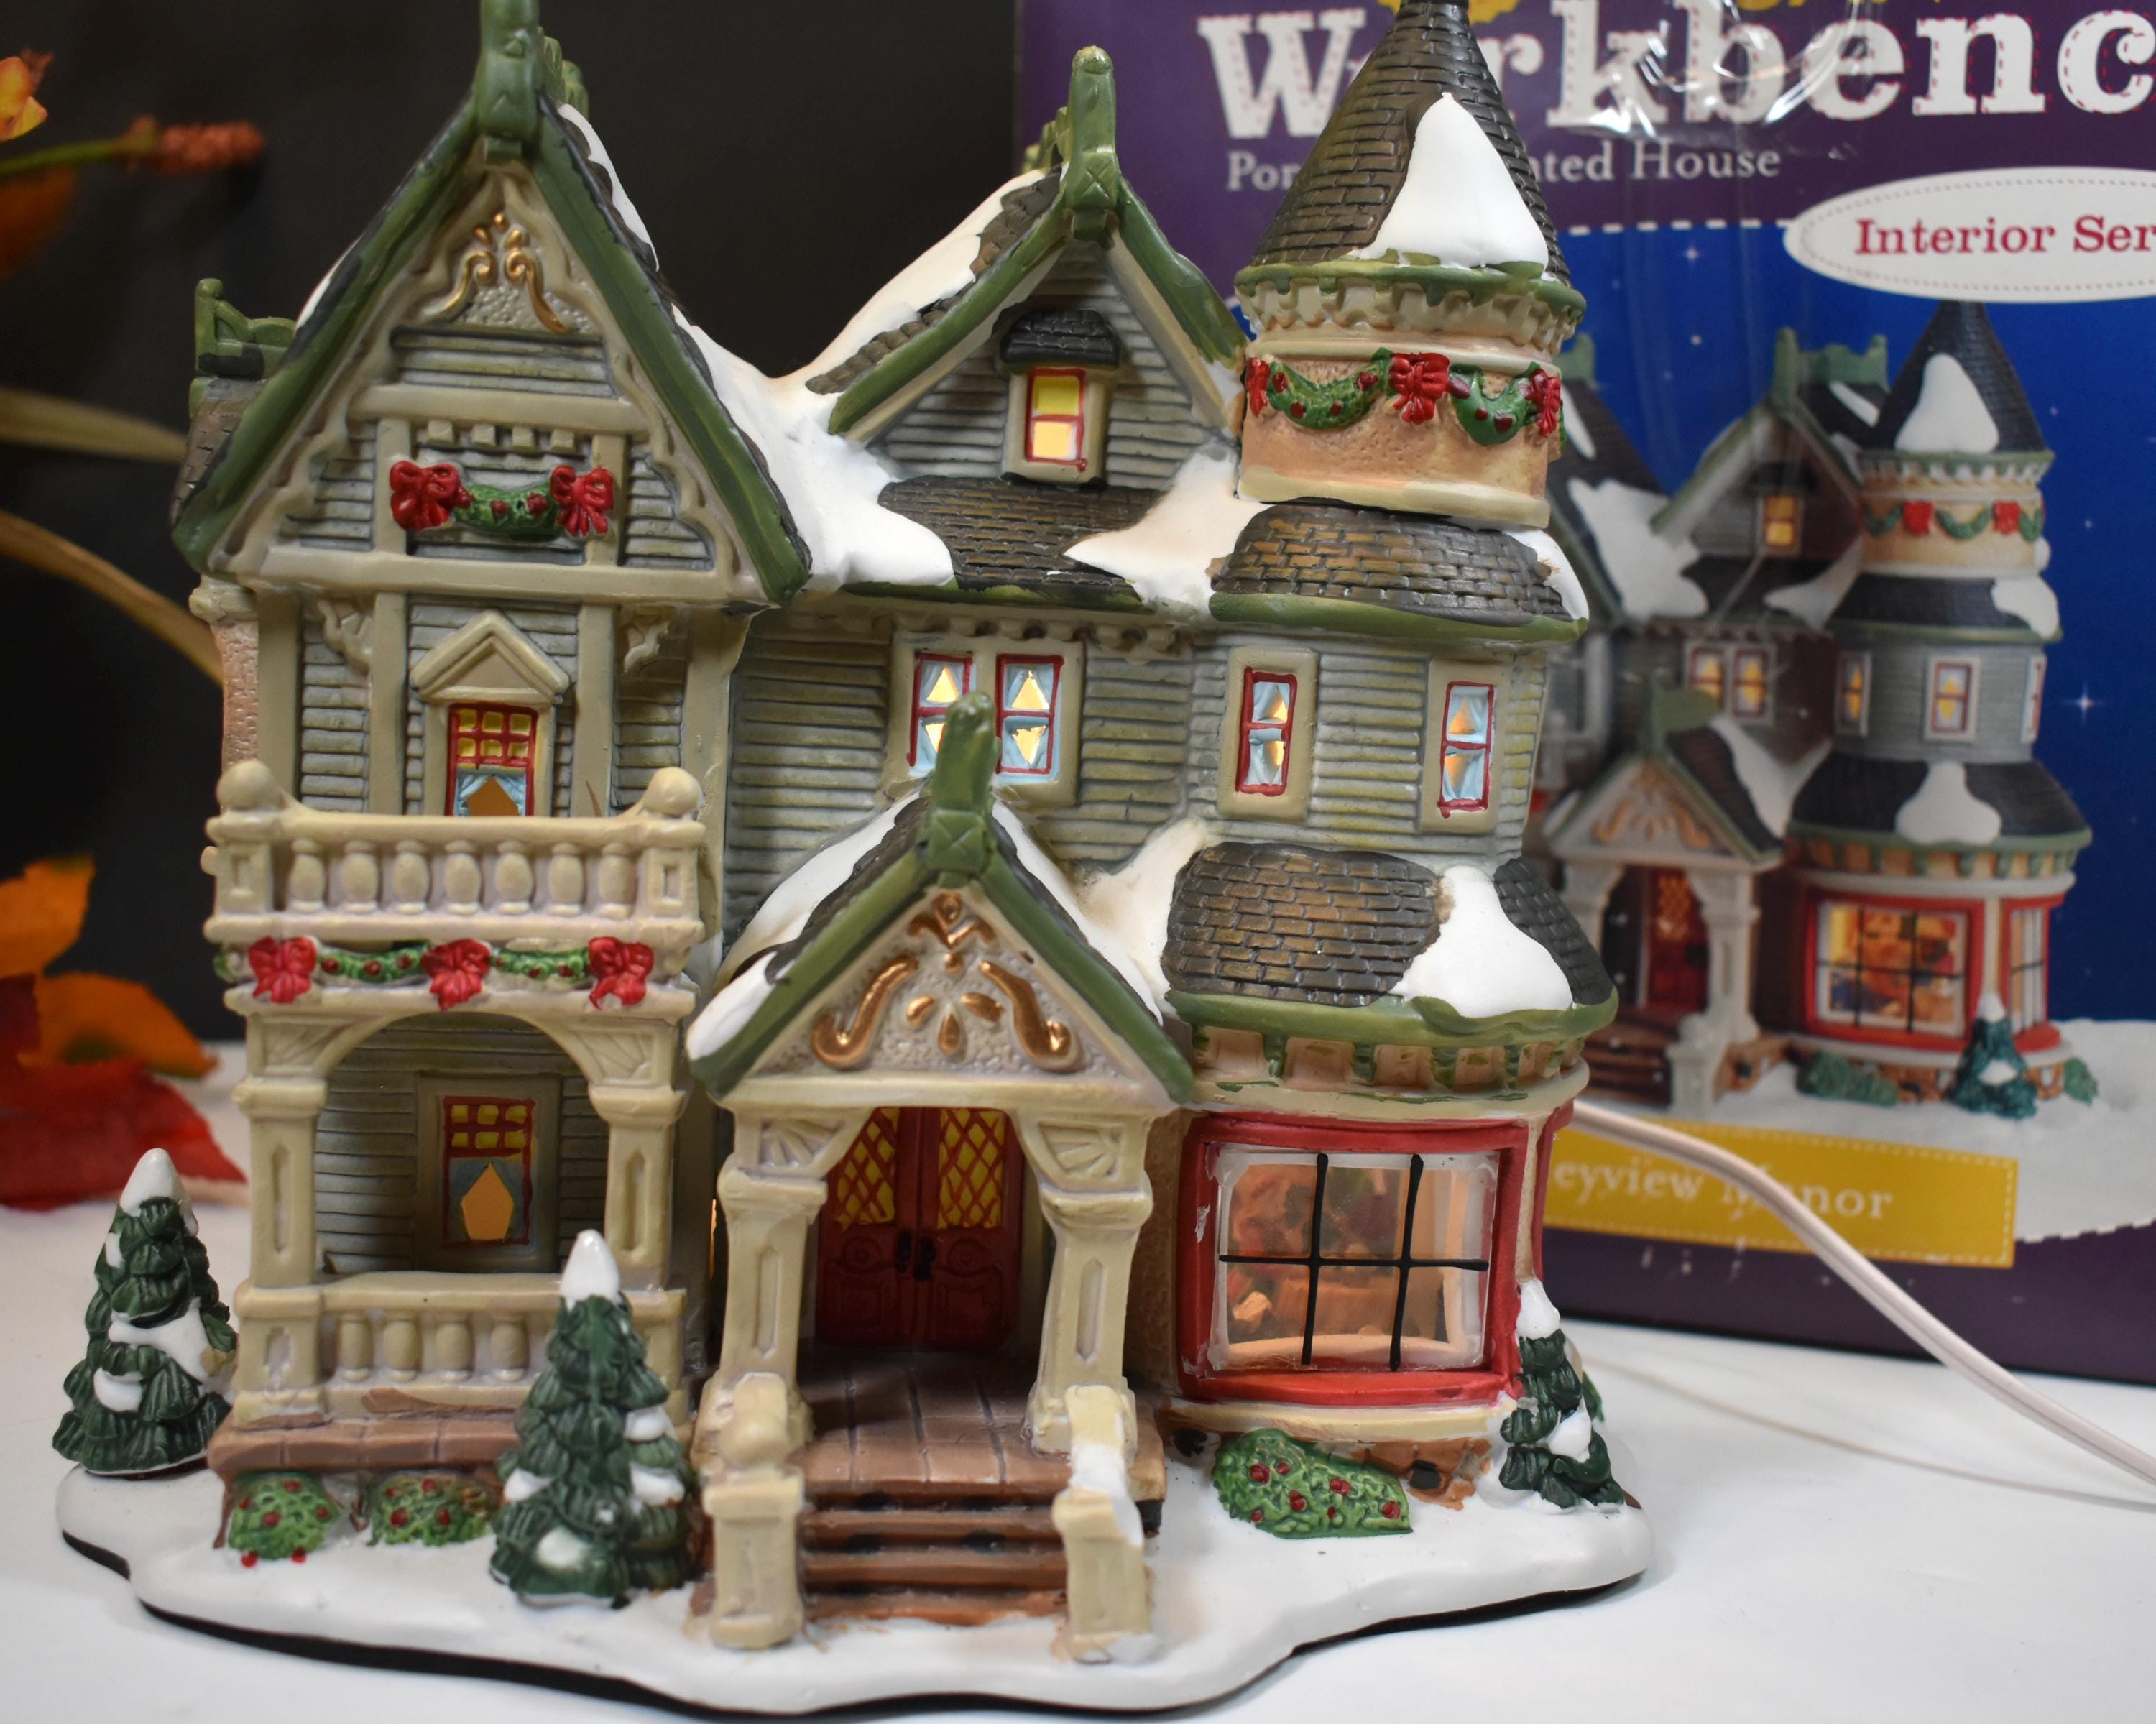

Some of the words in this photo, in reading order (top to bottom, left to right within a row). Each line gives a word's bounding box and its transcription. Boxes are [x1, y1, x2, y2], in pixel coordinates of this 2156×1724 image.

[1196, 0, 2156, 139] Wrkbenc
[1632, 138, 1781, 180] House
[1854, 217, 2055, 254] Interior
[2073, 214, 2156, 252] Ser
